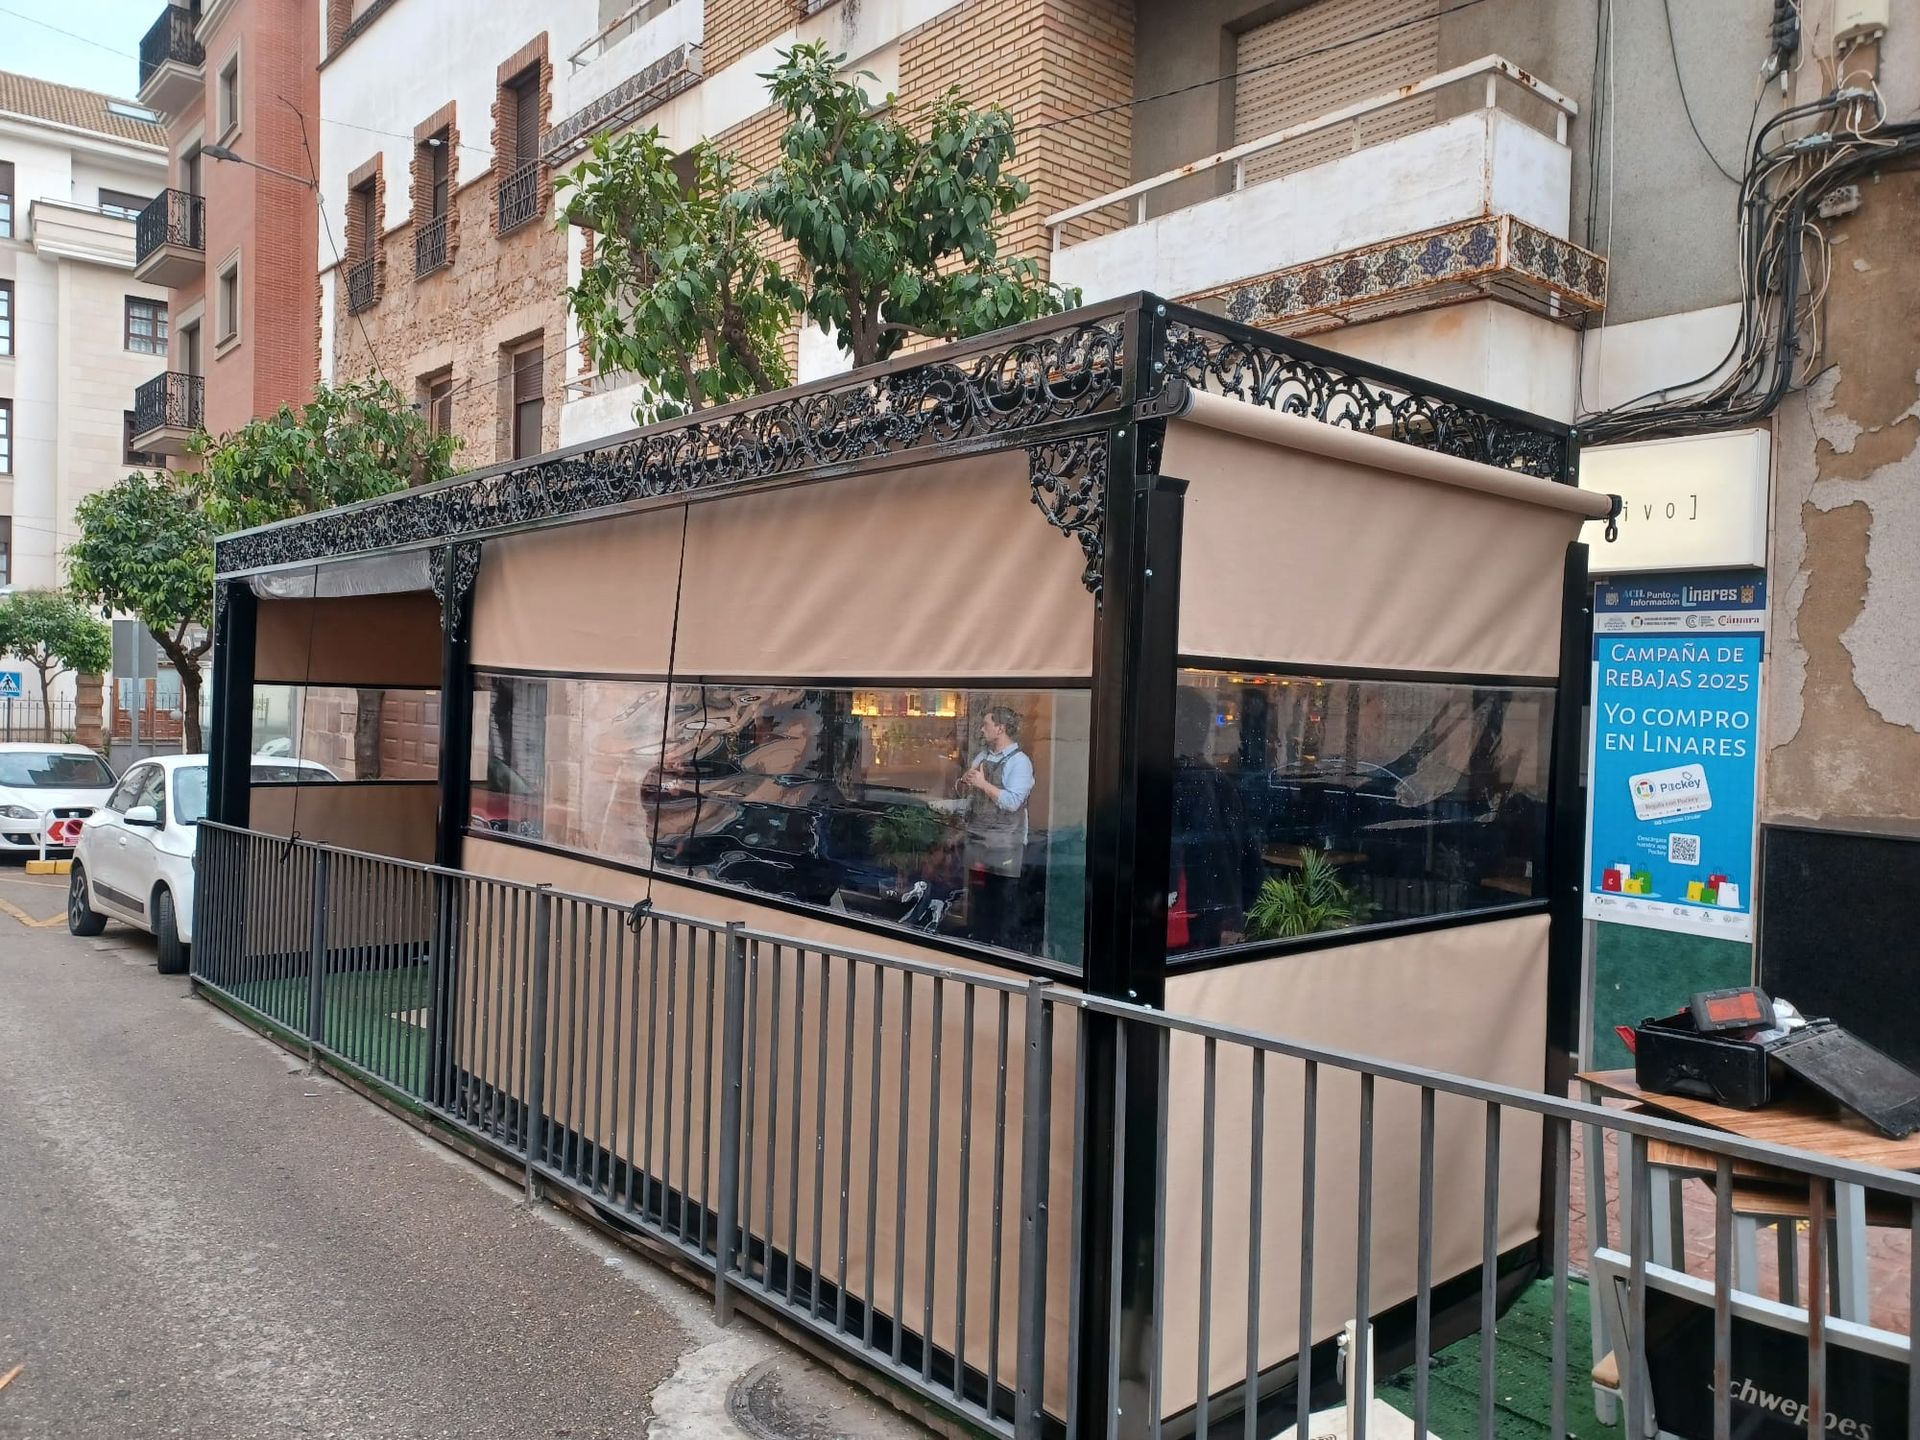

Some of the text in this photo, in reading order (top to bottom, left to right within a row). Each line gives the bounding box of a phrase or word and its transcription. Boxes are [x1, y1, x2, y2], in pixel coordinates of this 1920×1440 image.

[1630, 598, 1680, 607] Información
[1646, 591, 1671, 599] Punto
[1682, 586, 1738, 608] Linares
[1611, 642, 1744, 663] CAMPAÑA DE
[1697, 673, 1749, 692] 2025
[1642, 707, 1750, 730] COMPRO
[1605, 730, 1747, 757] EN LINARES
[1707, 1369, 1872, 1440] chwepes
